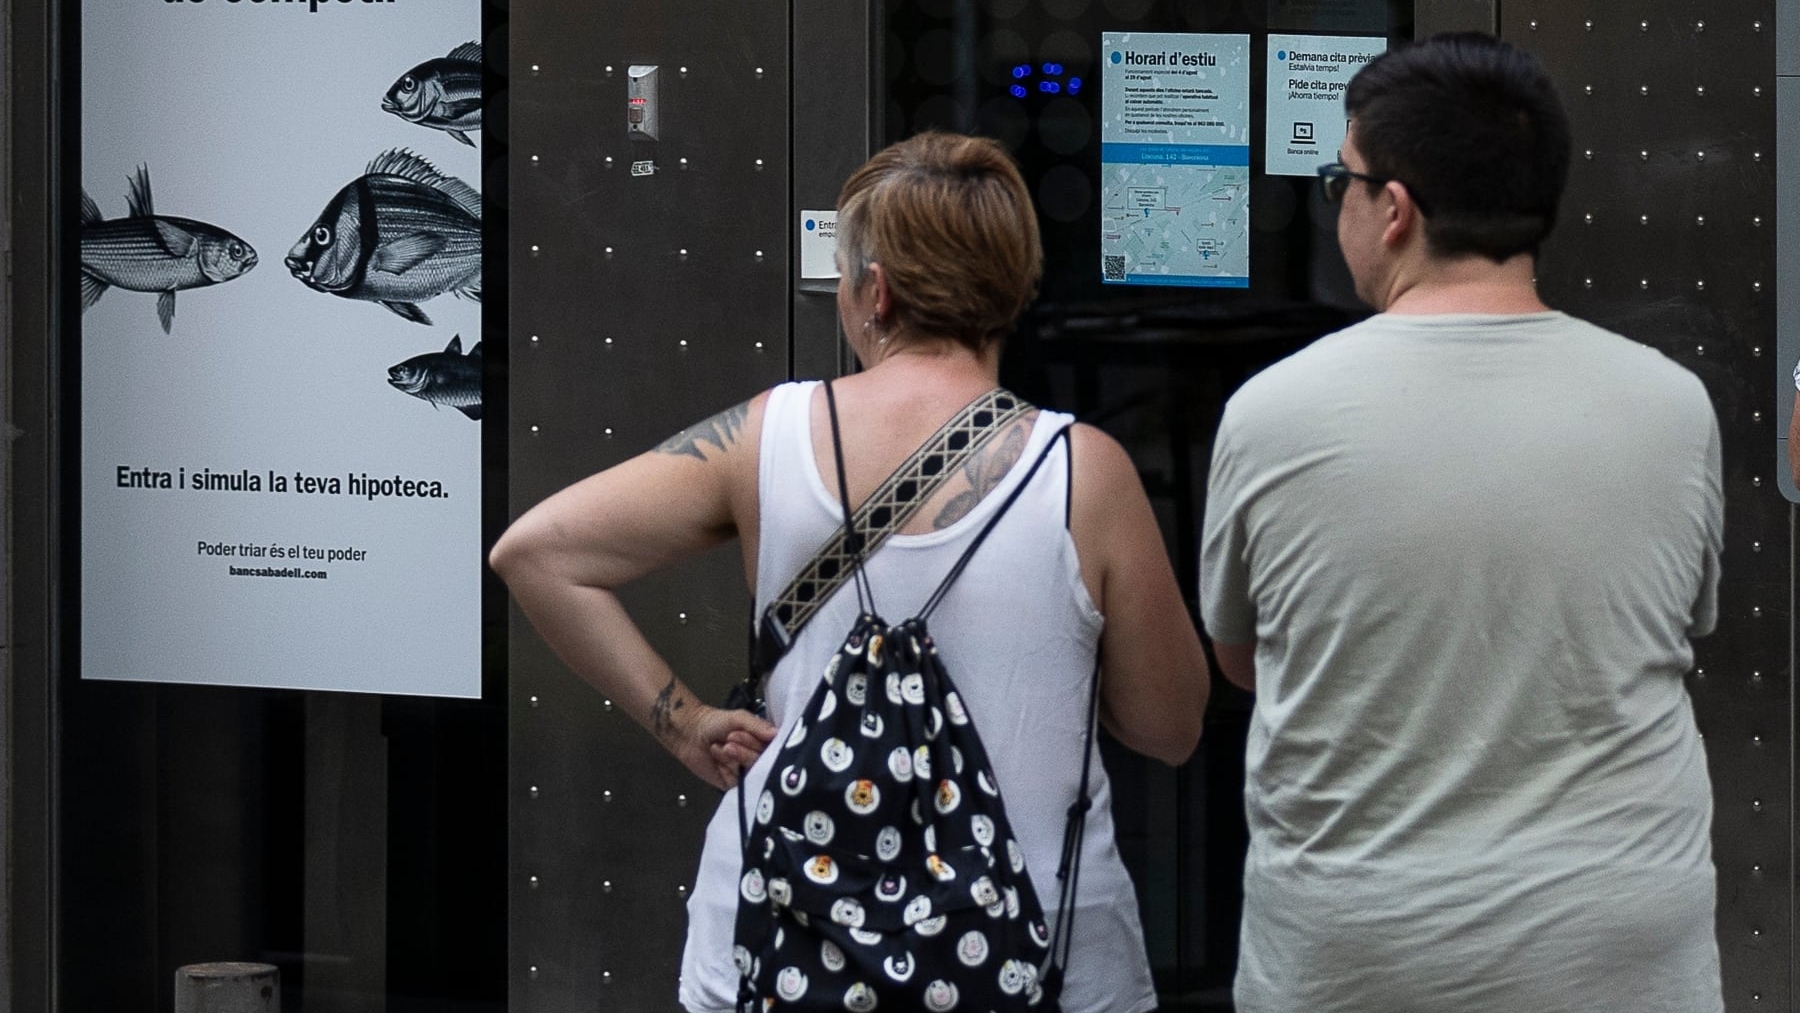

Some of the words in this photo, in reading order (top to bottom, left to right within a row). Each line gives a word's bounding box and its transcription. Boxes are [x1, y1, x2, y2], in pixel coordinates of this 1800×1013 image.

[1125, 50, 1165, 66] Horari
[1169, 52, 1216, 67] d'estiu
[1289, 51, 1329, 62] Demana
[1330, 52, 1347, 63] cita
[1289, 63, 1315, 71] Estalvia
[1289, 79, 1309, 90] Pide
[1310, 80, 1327, 90] cita
[117, 466, 172, 489] Entra
[179, 467, 185, 490] i
[191, 467, 262, 492] simula
[269, 470, 288, 493] la
[293, 473, 341, 495] teva
[348, 472, 449, 501] hipoteca.
[197, 540, 237, 557] Poder
[238, 542, 267, 558] triar
[269, 543, 286, 559] és
[287, 544, 300, 559] el
[302, 545, 325, 561] teu
[327, 546, 367, 563] poder
[229, 565, 328, 580] bancsabadell.com
